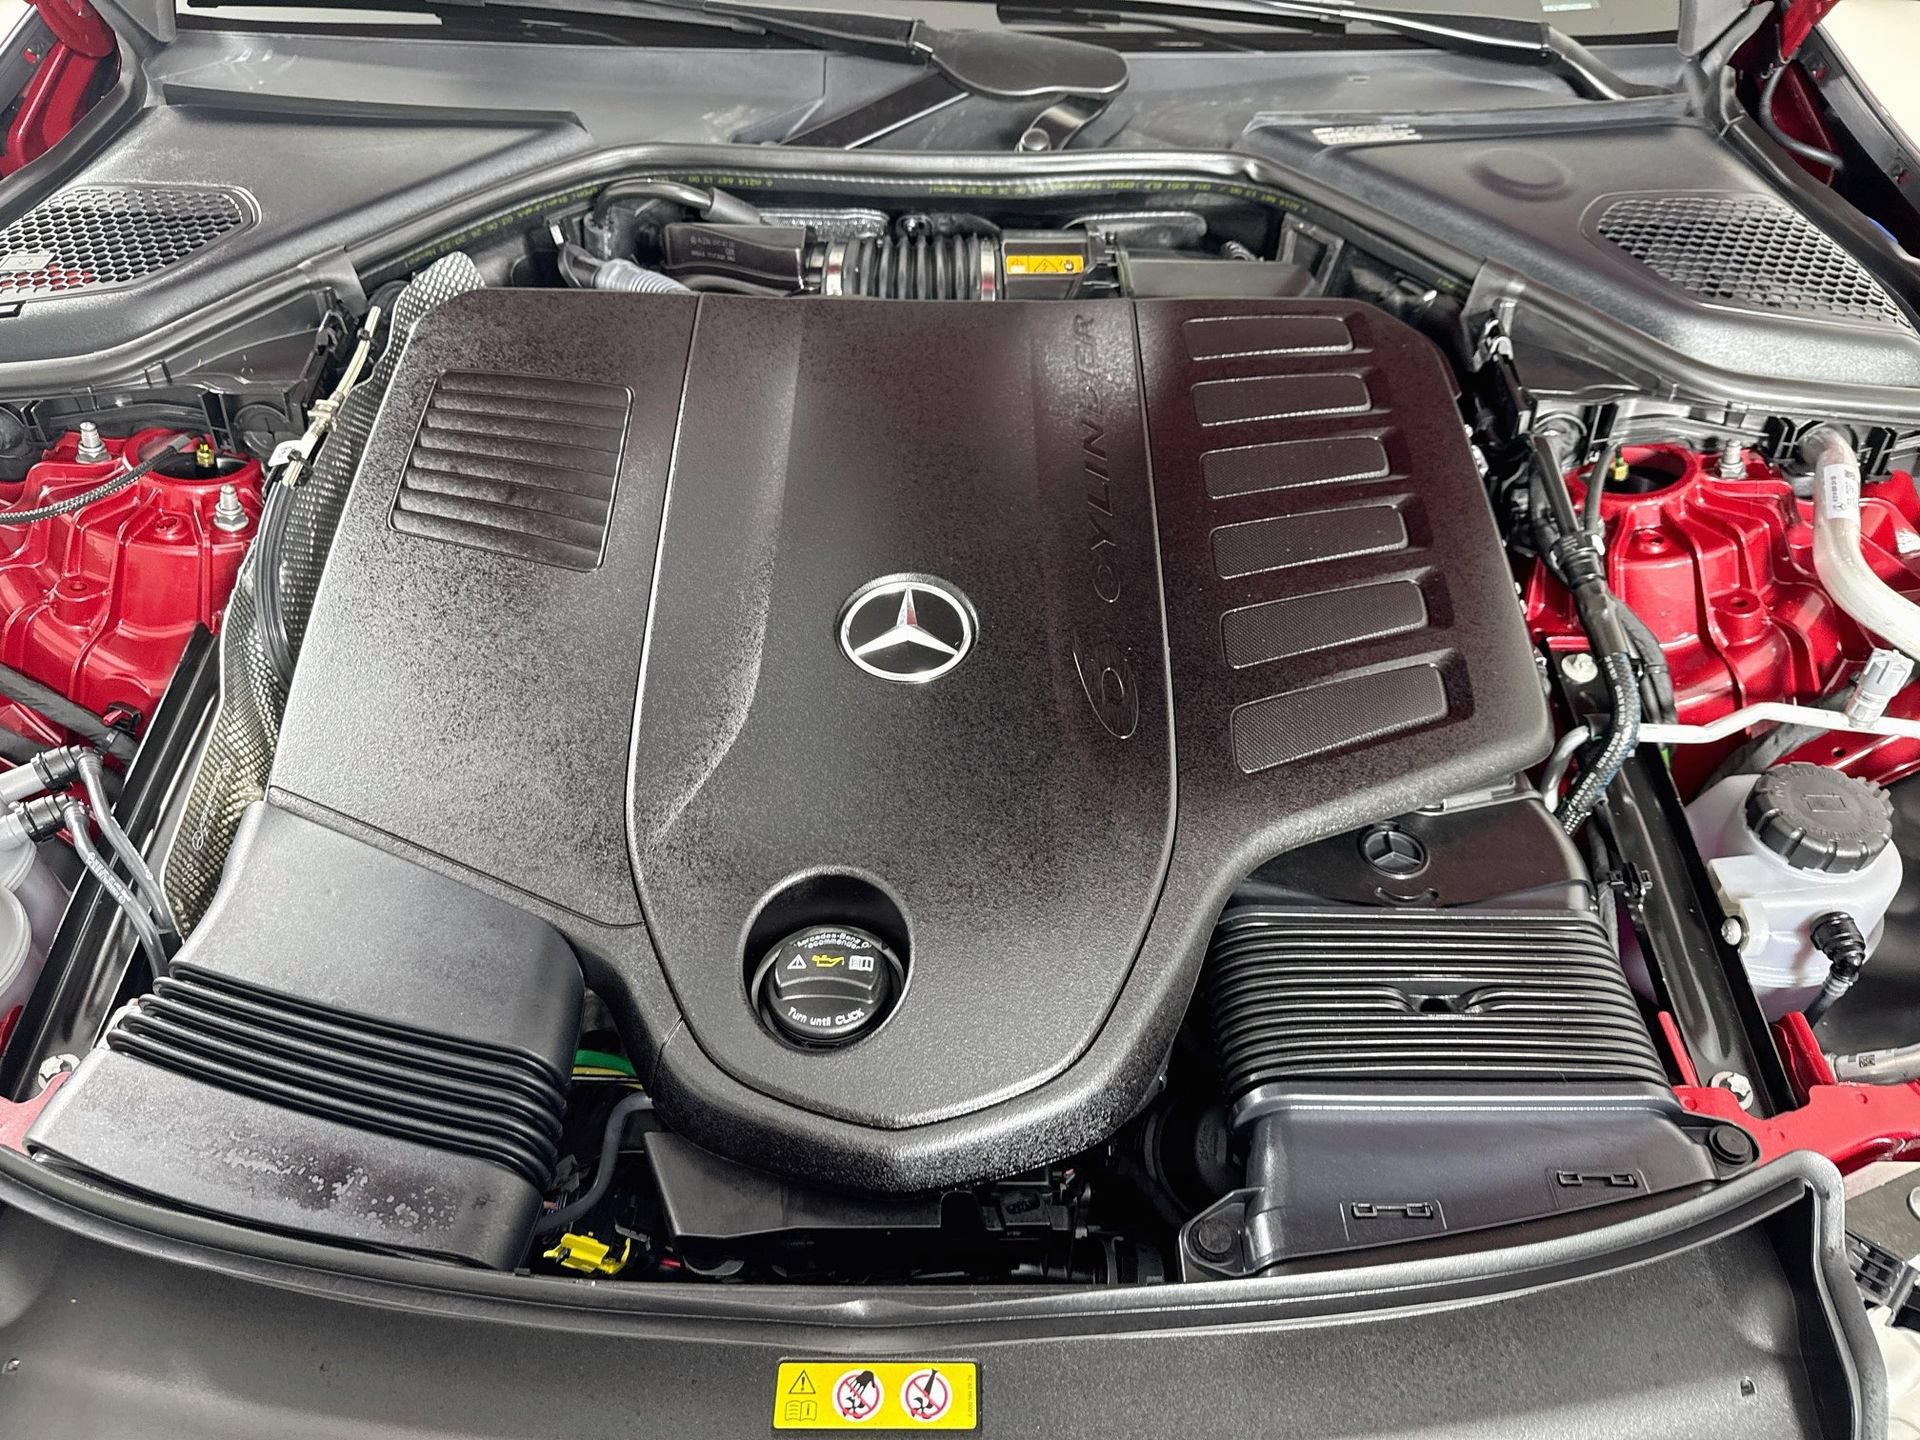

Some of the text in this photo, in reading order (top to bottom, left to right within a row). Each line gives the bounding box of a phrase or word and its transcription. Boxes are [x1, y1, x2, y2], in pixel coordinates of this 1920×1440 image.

[1072, 313, 1139, 740] 6 CYLINDER
[788, 1006, 865, 1026] Turn until CLICK
